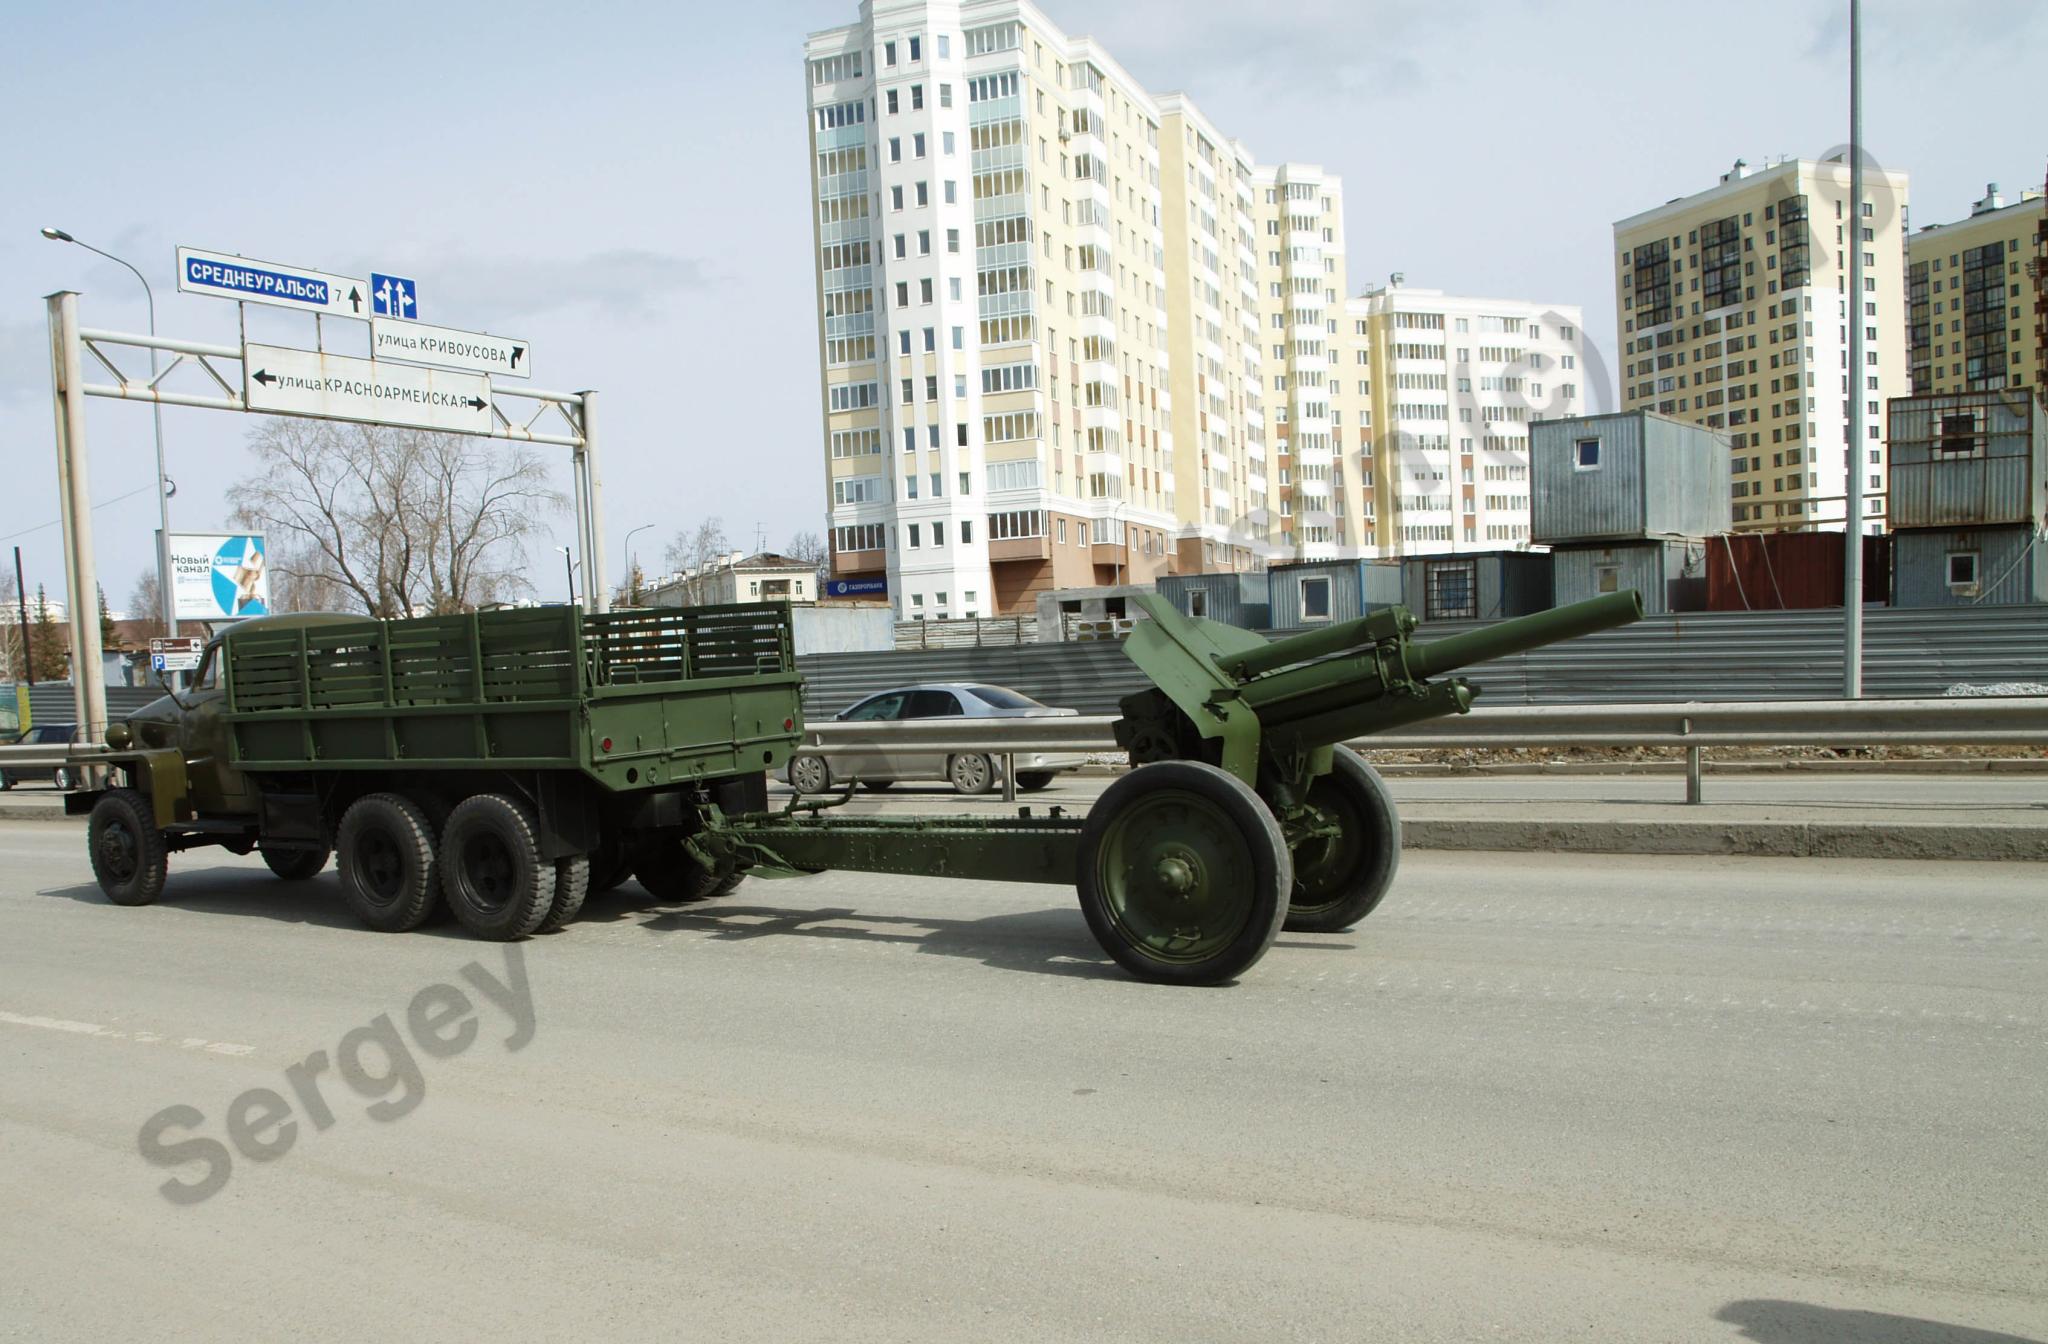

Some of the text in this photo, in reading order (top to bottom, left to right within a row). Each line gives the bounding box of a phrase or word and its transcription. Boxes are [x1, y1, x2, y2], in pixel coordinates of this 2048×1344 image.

[190, 263, 342, 302] СРЕДНЕУРАЛЬСК 7
[377, 333, 507, 363] улица КРИВОУСОВА
[277, 375, 322, 394] улица
[171, 554, 209, 564] Новый
[176, 565, 210, 573] канал
